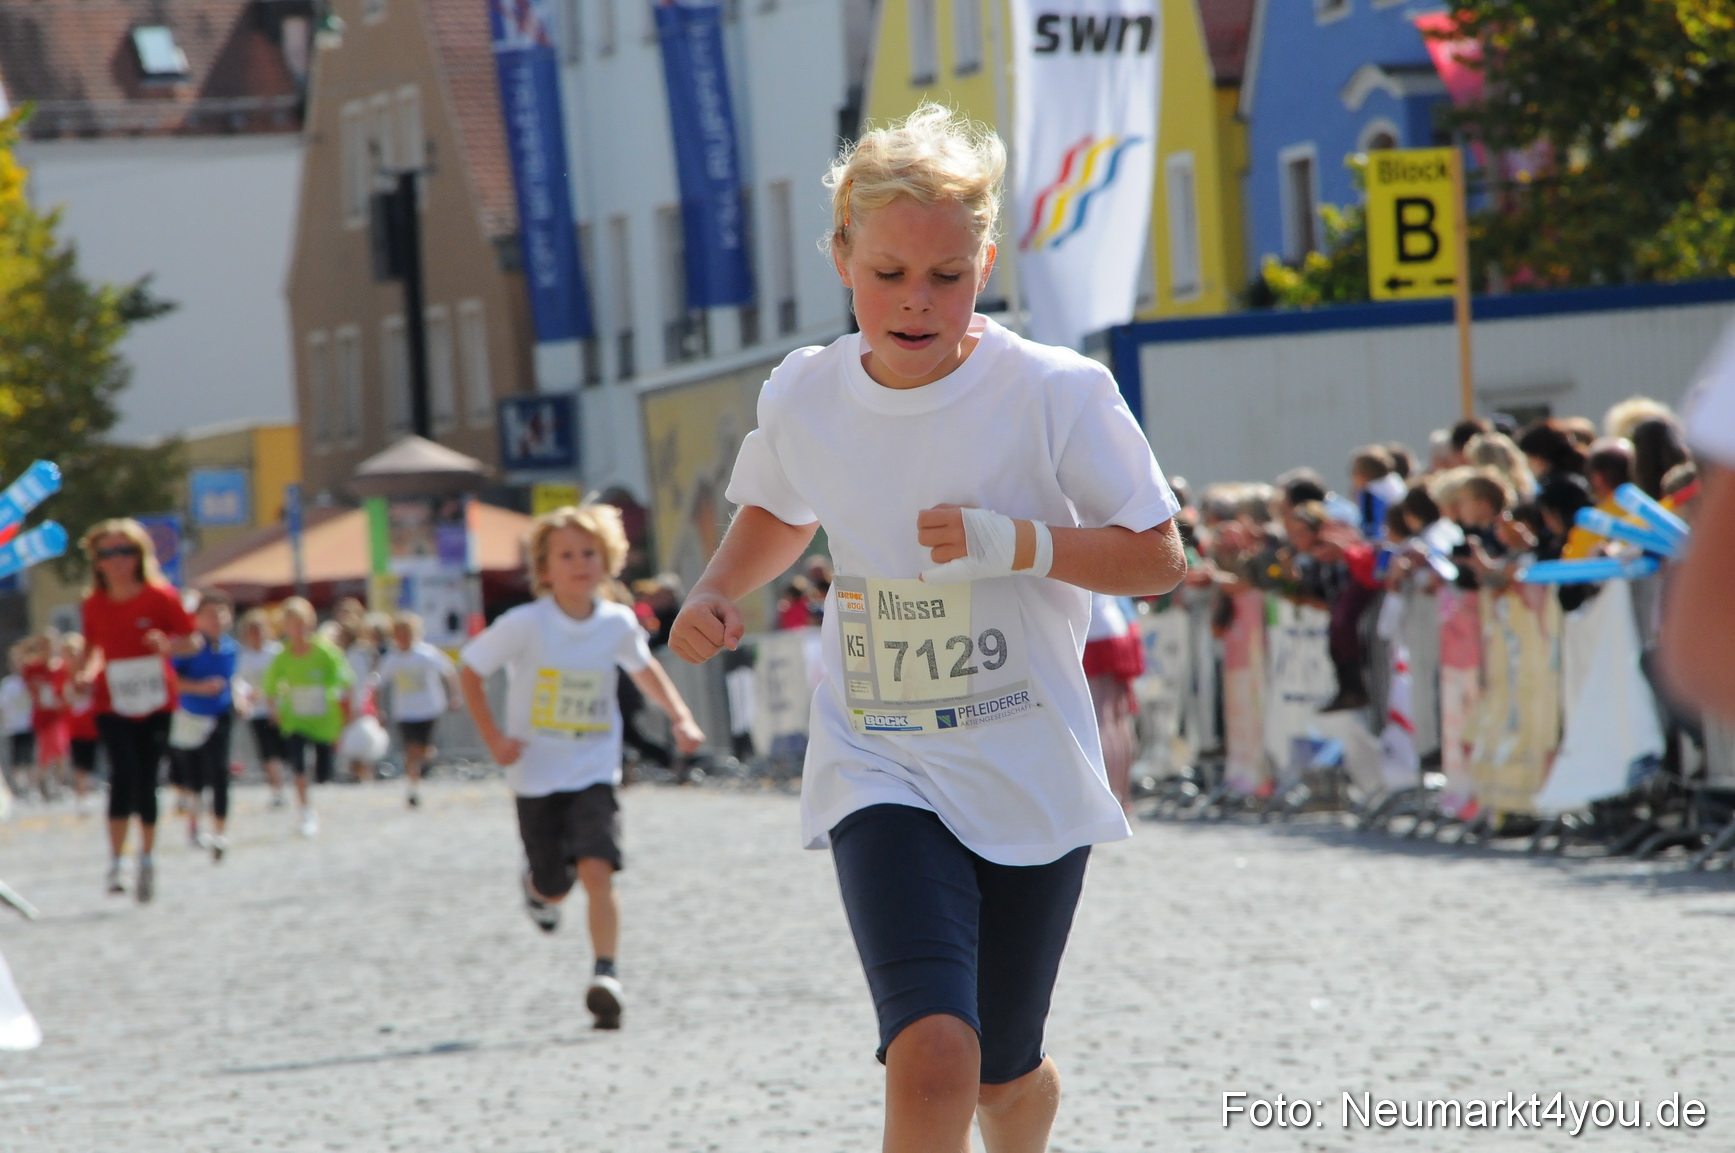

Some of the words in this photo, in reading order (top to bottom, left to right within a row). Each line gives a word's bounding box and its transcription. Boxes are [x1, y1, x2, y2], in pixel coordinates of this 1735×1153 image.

[1034, 15, 1152, 53] swn
[1377, 155, 1451, 184] Block
[1395, 198, 1440, 263] B
[878, 590, 946, 620] Alissa
[846, 634, 865, 657] K5
[884, 628, 1008, 682] 7129
[957, 691, 1030, 719] PFLEIDERER
[960, 704, 1032, 726] AKTIENGESELLSCHAFT
[864, 714, 909, 727] BOCK
